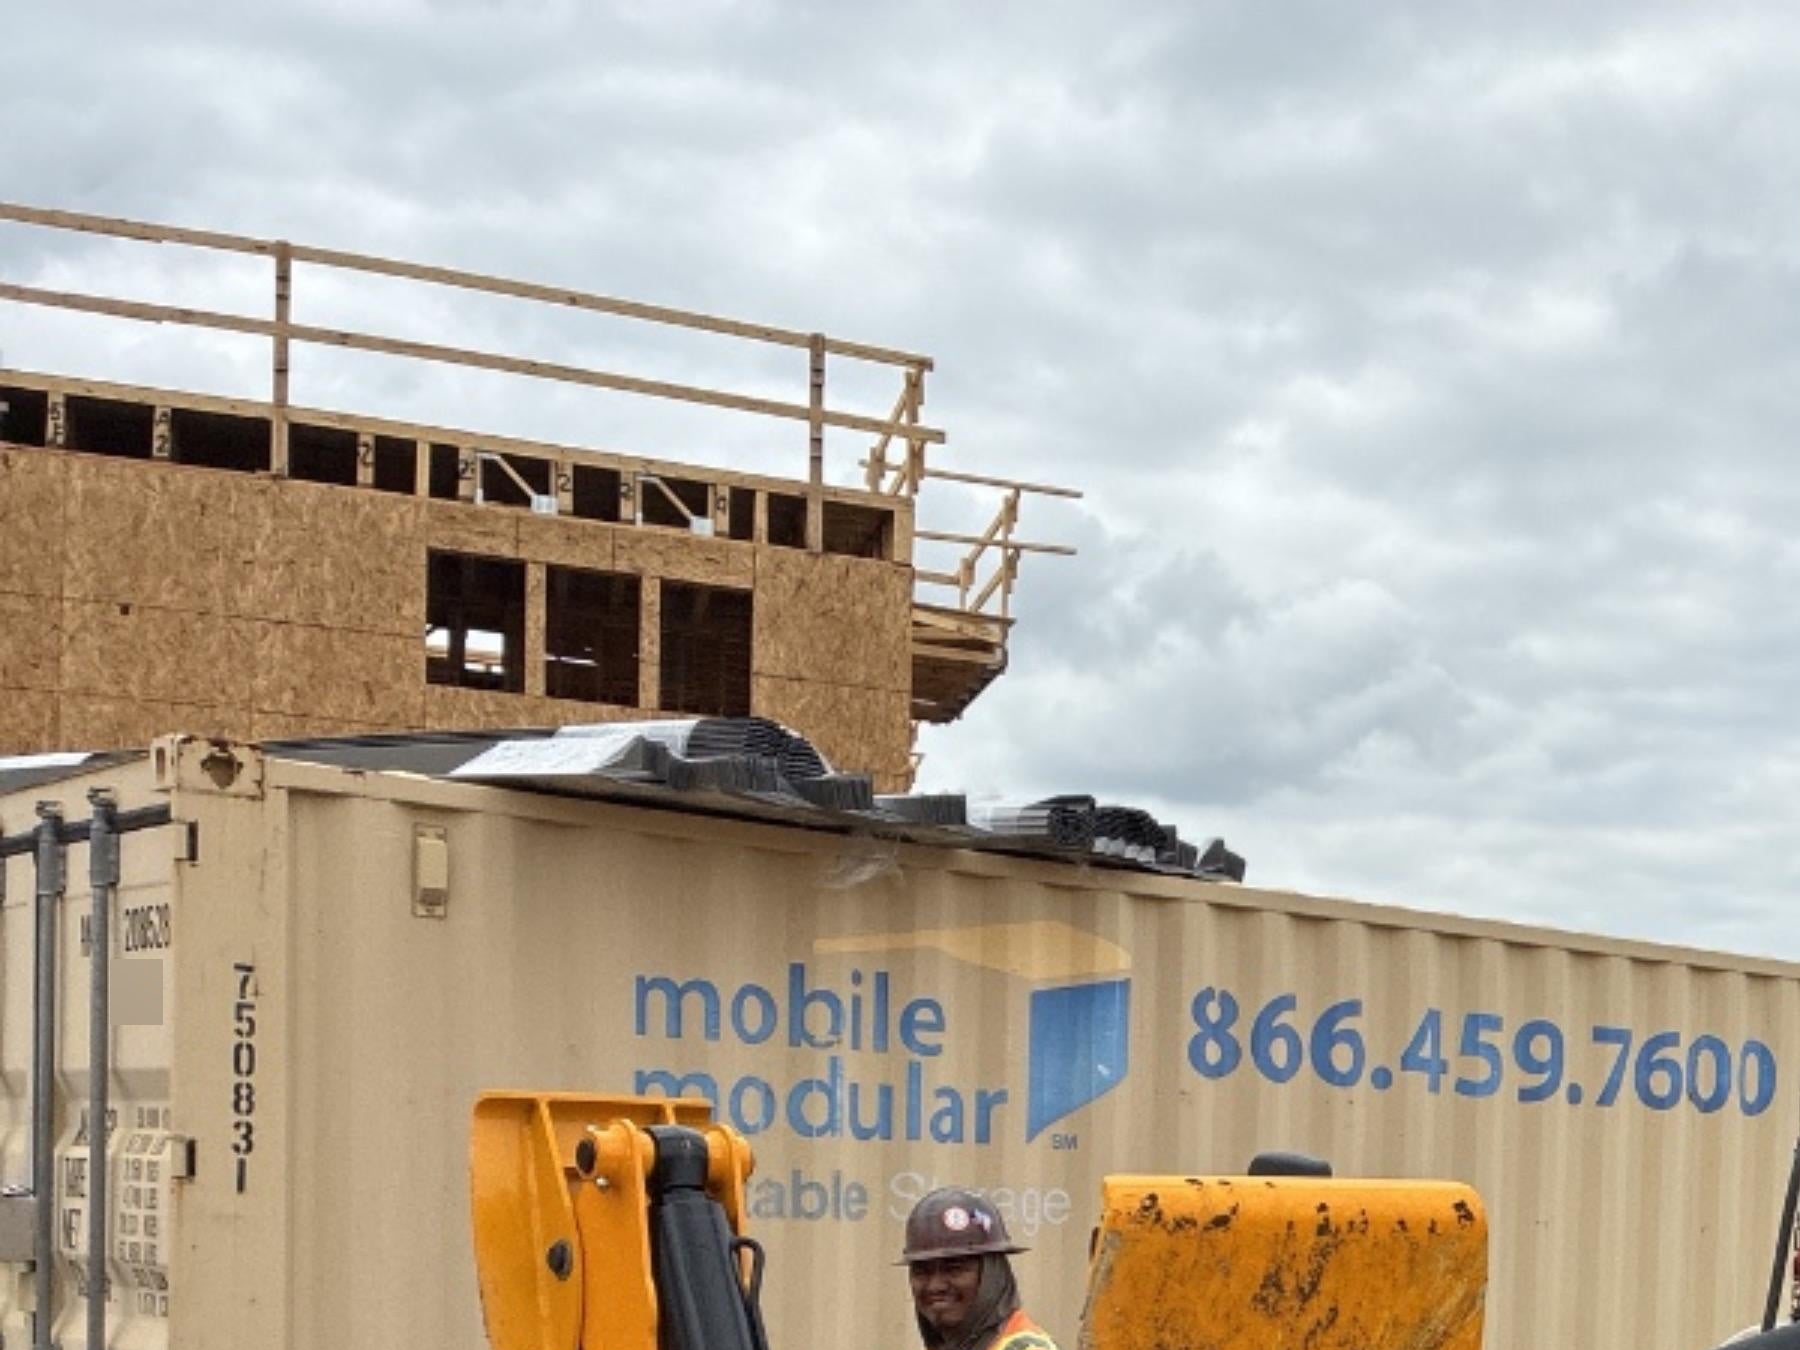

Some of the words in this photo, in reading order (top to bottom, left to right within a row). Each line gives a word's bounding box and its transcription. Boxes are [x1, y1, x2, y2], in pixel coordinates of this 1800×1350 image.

[634, 962, 946, 1057] mobile
[1187, 985, 1778, 1117] 866.459.7600
[888, 1171, 1072, 1237] Sage
